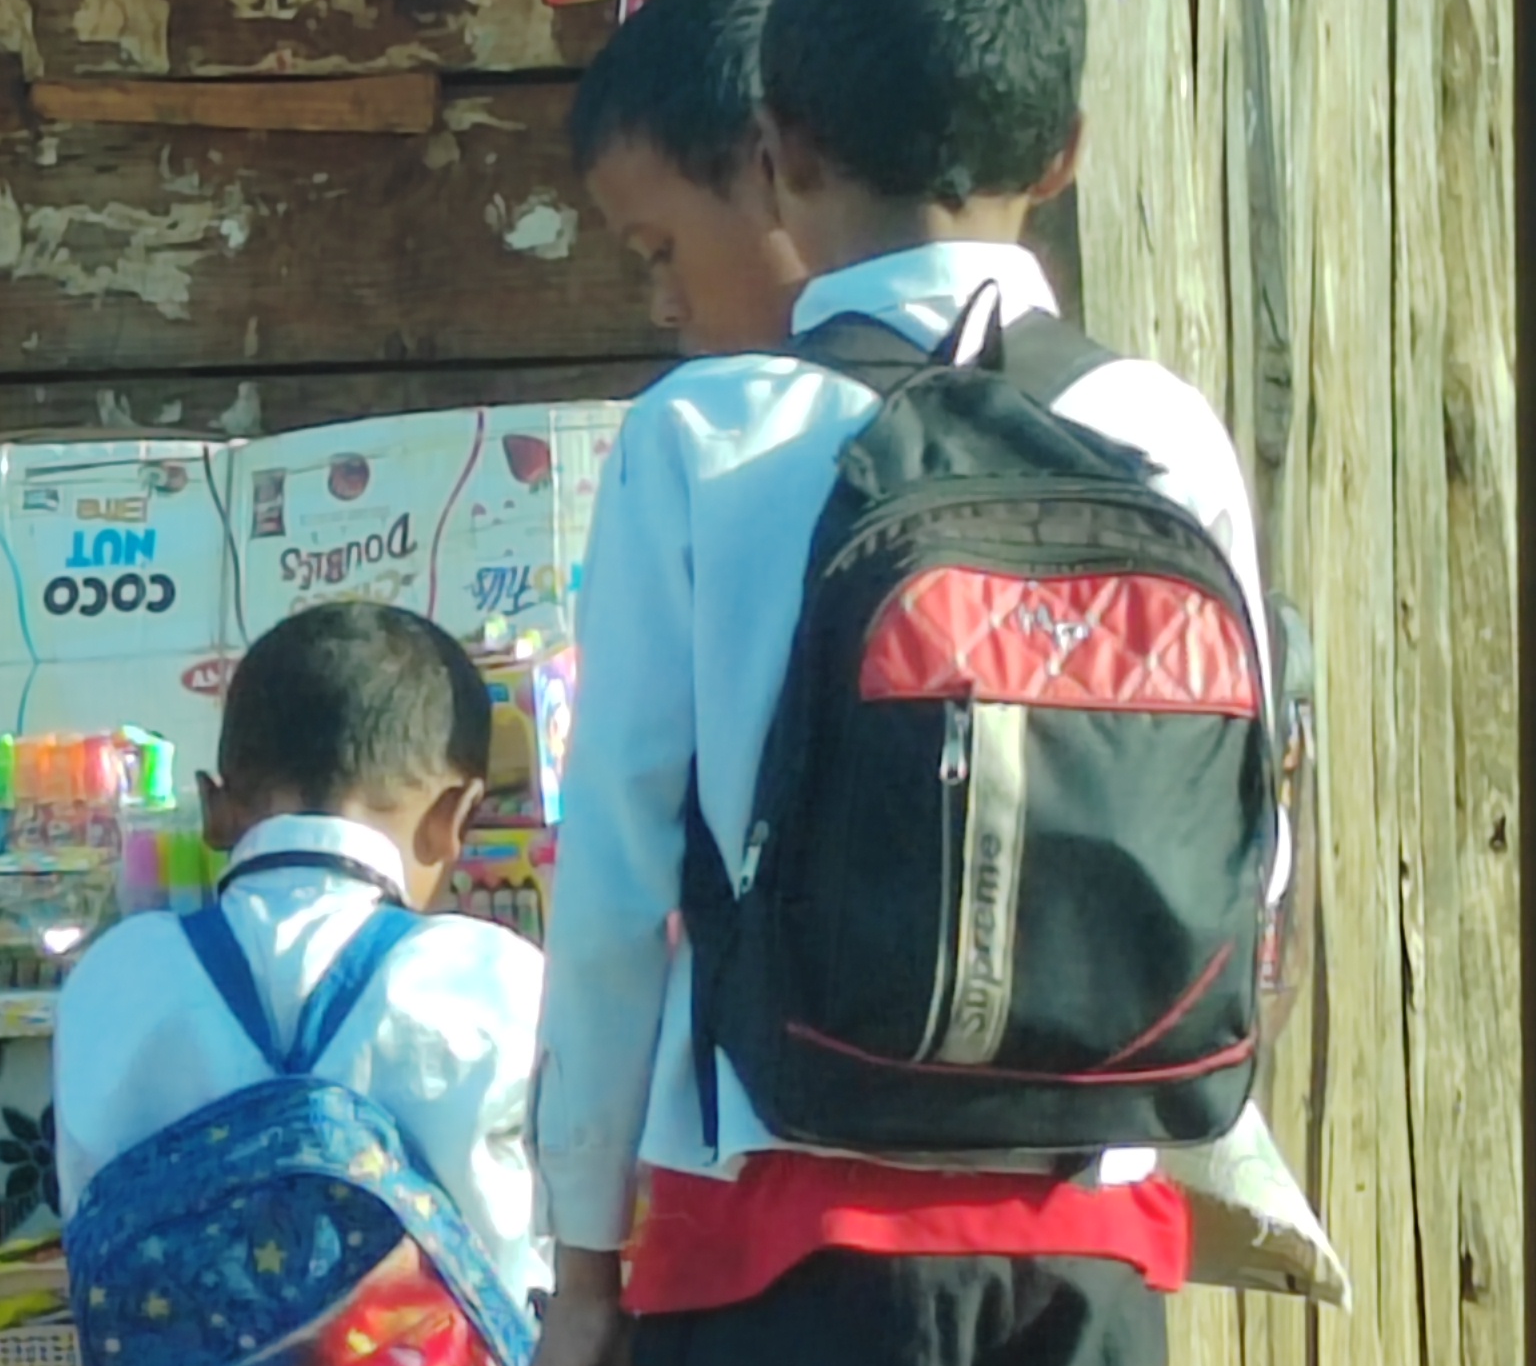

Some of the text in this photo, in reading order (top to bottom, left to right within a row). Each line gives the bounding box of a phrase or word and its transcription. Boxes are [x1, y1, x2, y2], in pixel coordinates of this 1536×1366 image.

[66, 528, 157, 569] NUT
[280, 511, 418, 592] DOUBLES
[42, 572, 177, 616] COCO
